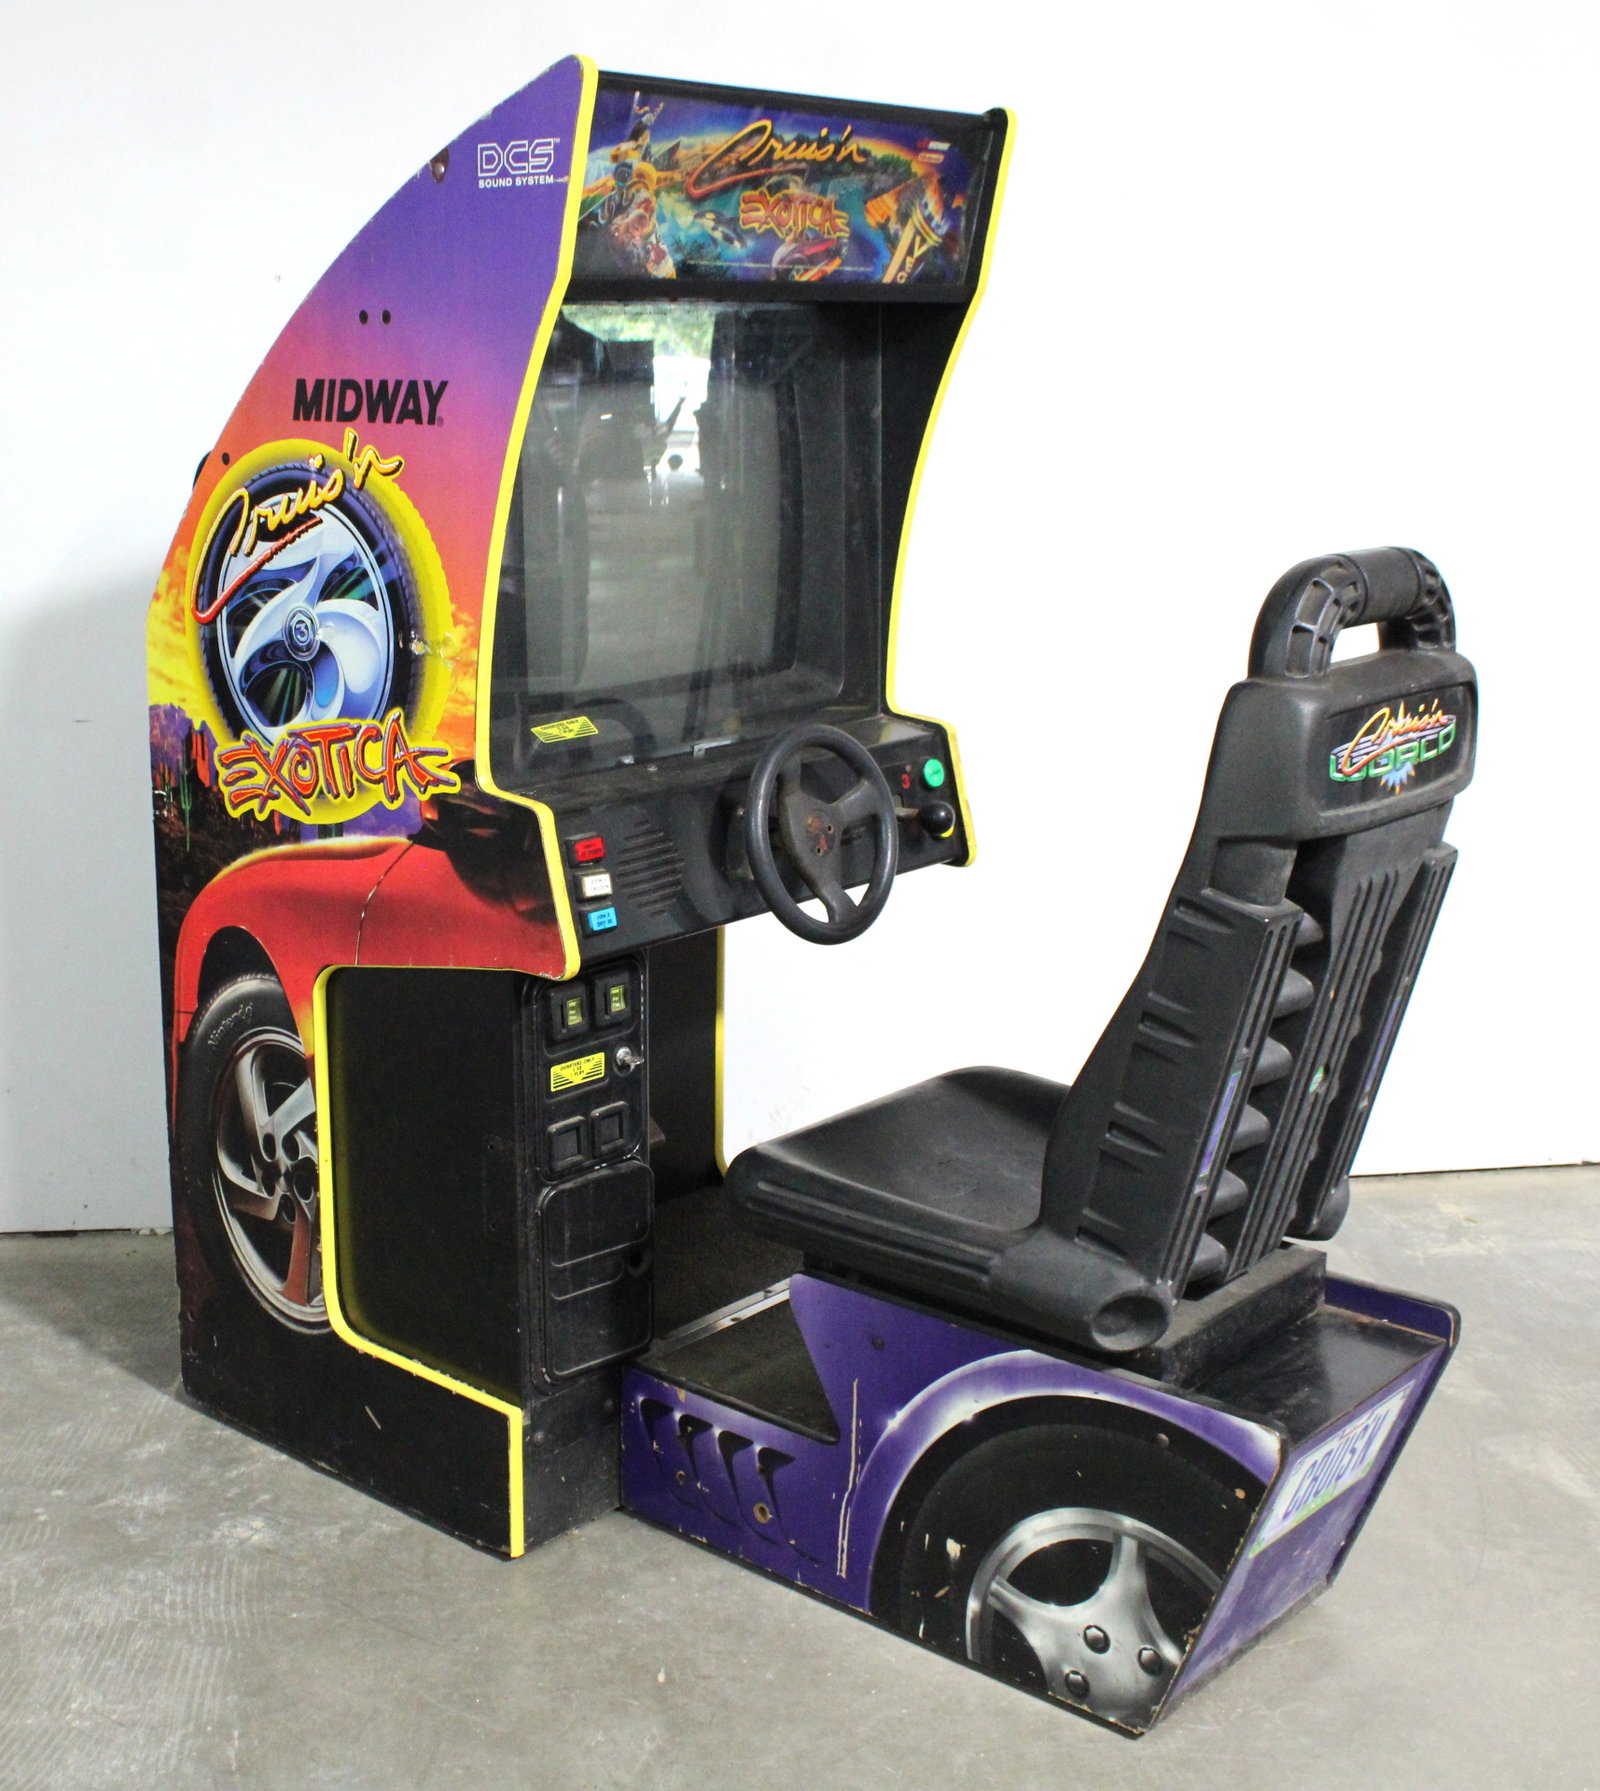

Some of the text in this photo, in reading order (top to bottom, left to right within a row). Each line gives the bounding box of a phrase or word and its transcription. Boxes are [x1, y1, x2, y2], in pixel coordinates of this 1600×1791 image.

[477, 138, 554, 177] DCS
[479, 174, 554, 189] SOUND SYSTEM
[740, 187, 850, 238] EXOTICA
[293, 378, 449, 426] MIDWAY
[215, 711, 460, 817] EXOTICA
[208, 1003, 253, 1050] Nintendo
